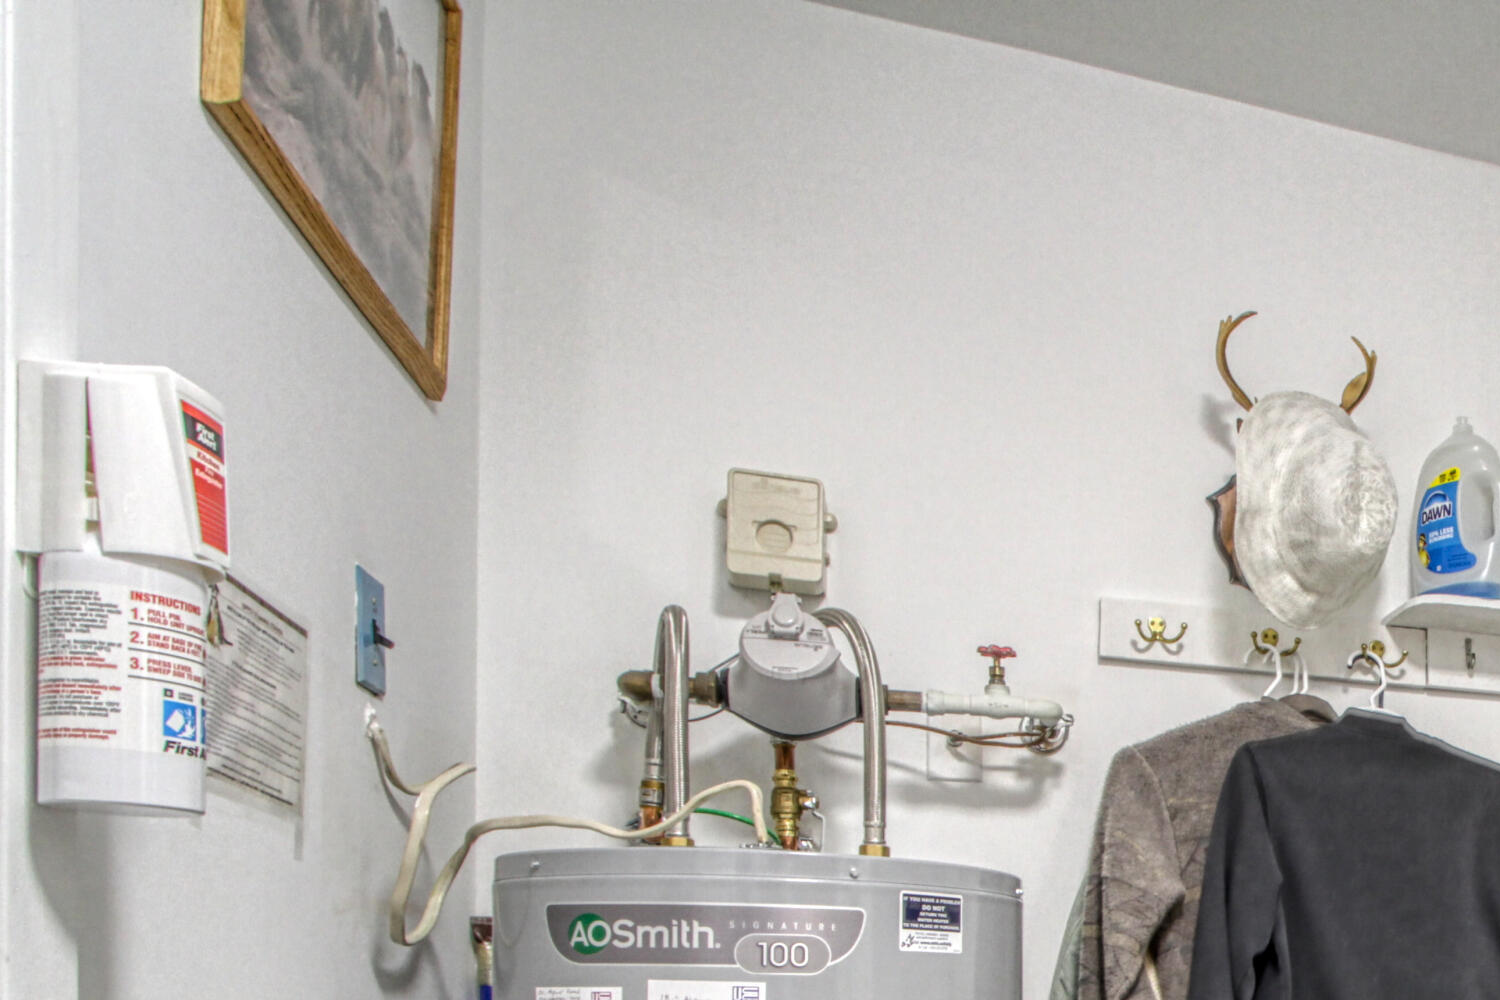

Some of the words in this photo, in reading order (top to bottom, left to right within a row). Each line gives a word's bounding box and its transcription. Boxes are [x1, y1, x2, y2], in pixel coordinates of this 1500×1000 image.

[1421, 502, 1453, 525] DAWN
[130, 590, 201, 617] INSTRUCTIONS
[163, 739, 198, 758] First
[729, 920, 837, 932] SIGNATURE
[757, 942, 809, 967] 100
